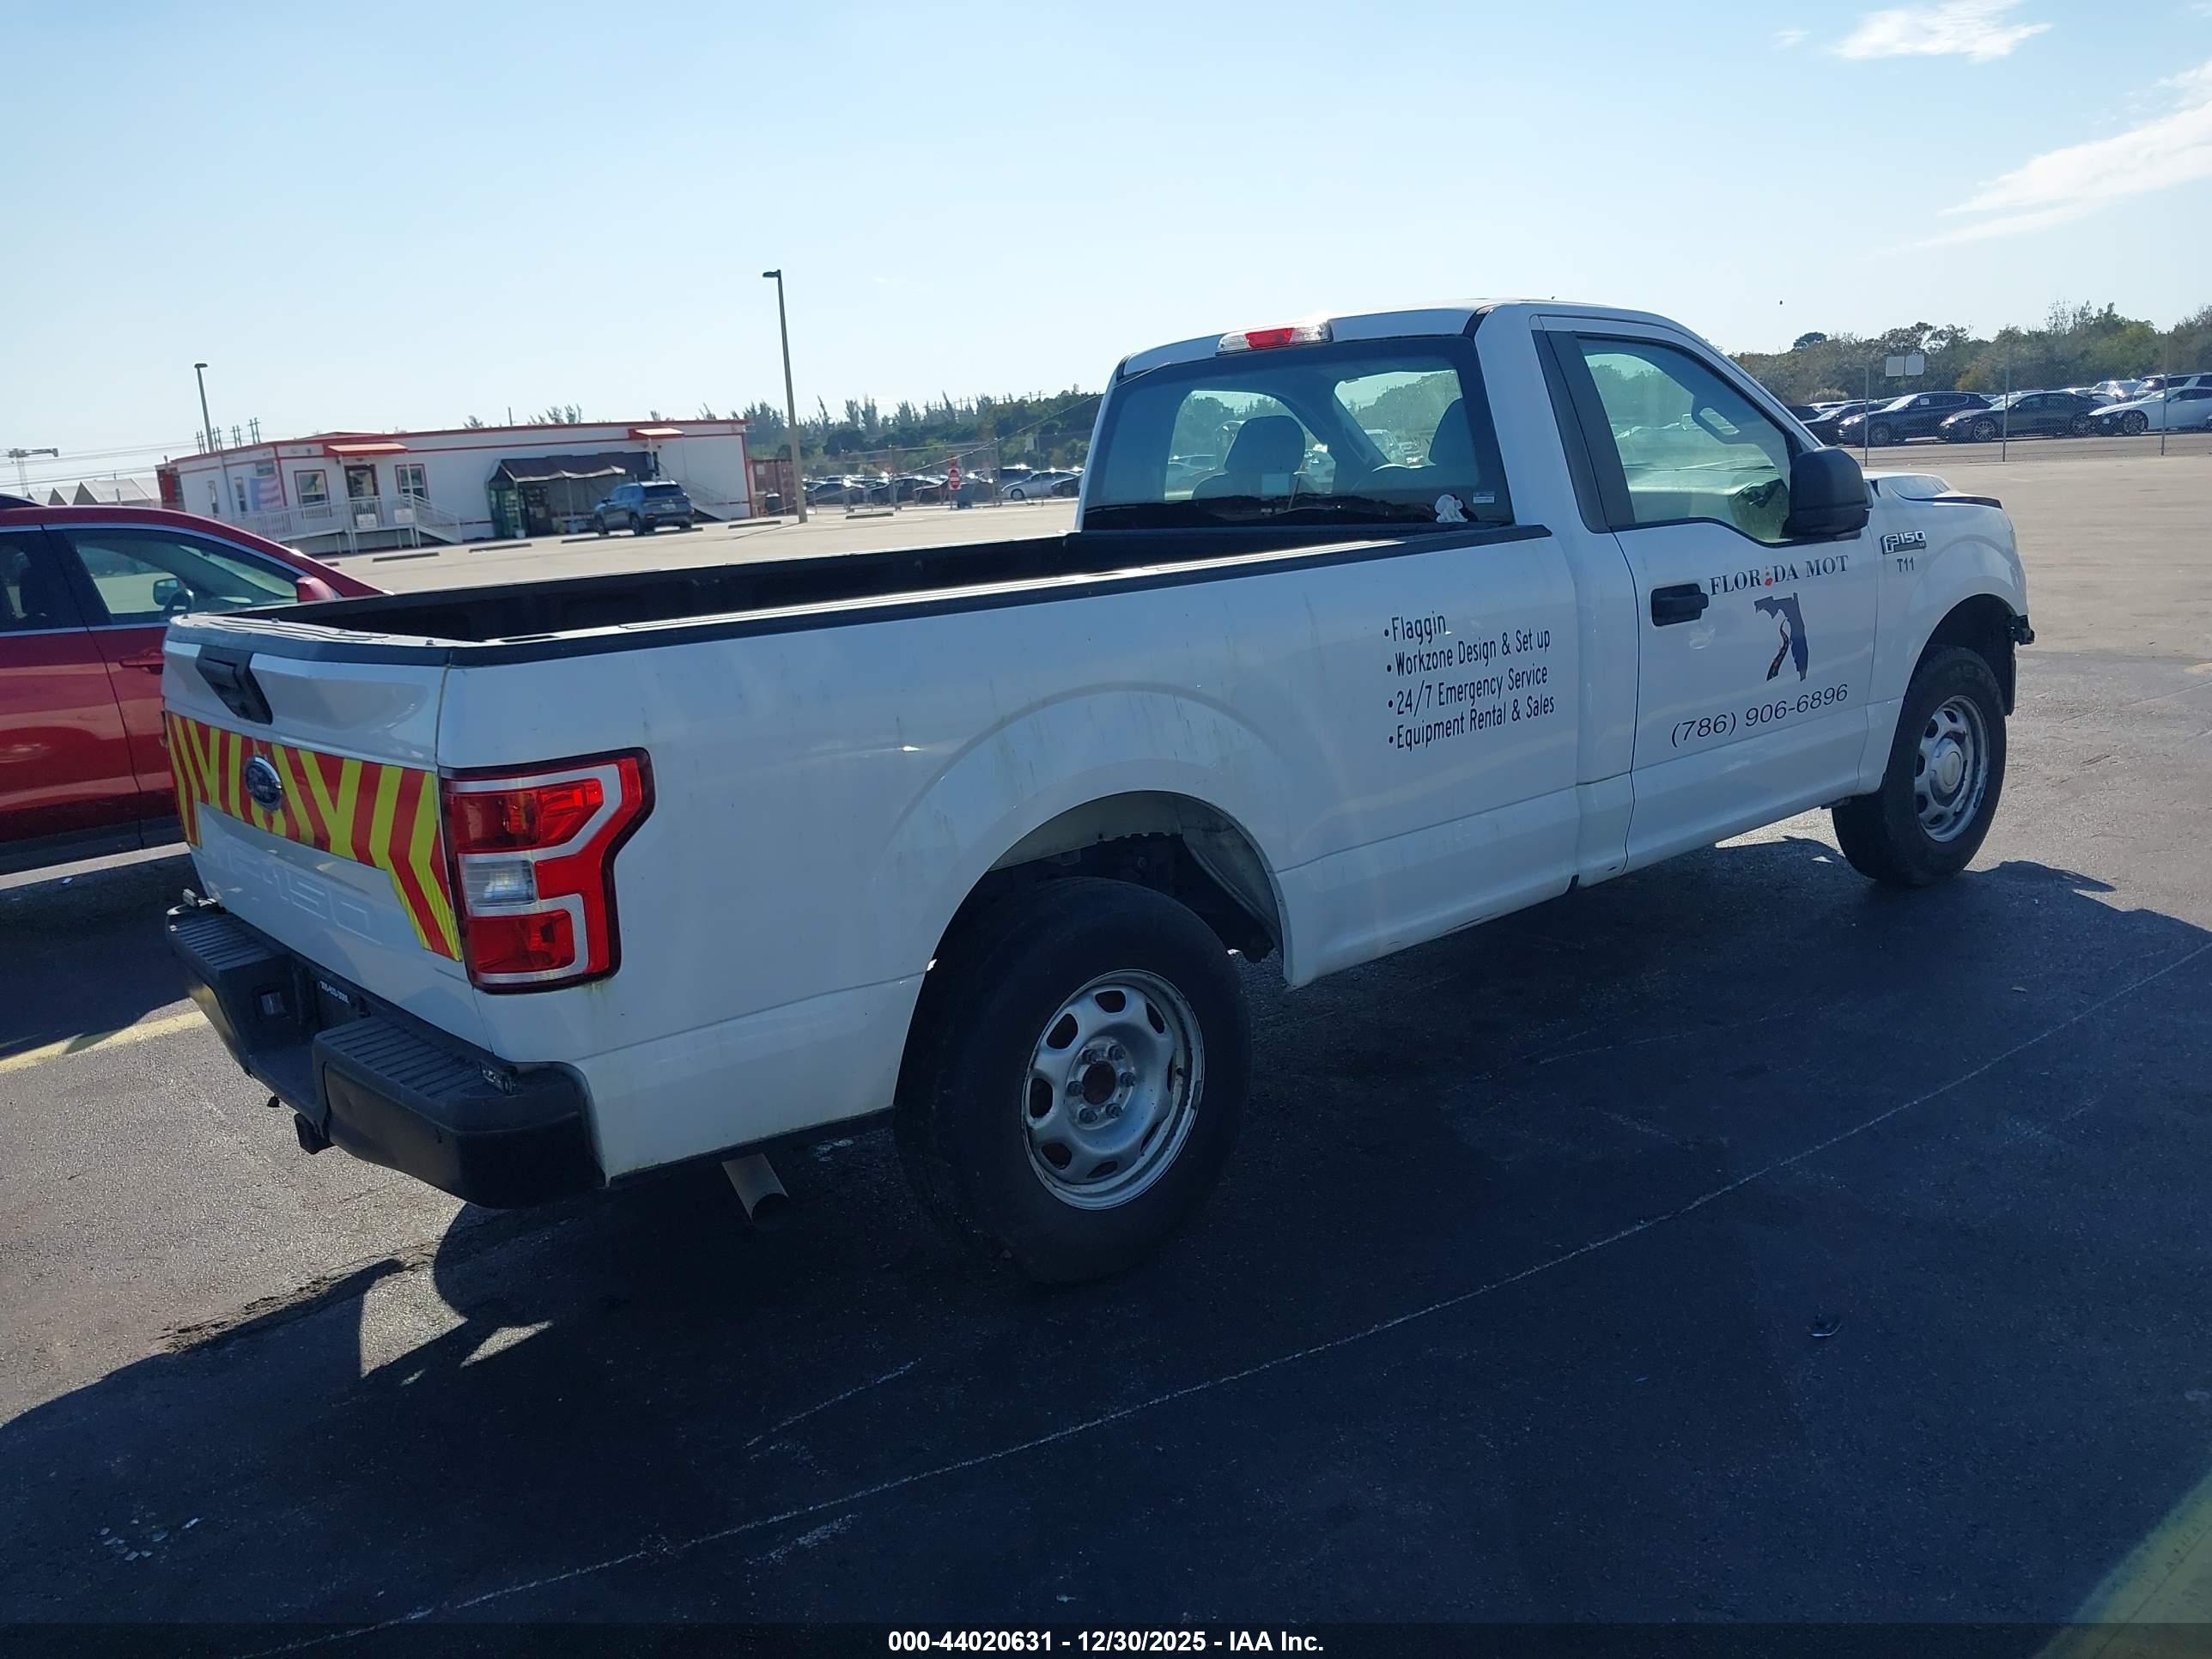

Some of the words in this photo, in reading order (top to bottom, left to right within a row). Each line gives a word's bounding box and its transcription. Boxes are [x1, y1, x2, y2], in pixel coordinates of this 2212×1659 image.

[1804, 555, 1849, 578] MOT
[1391, 611, 1446, 646] Flaggin
[1395, 648, 1454, 677] Workzone
[1457, 636, 1497, 666] Design
[1501, 631, 1511, 656] &
[1516, 628, 1533, 653] Set
[1536, 629, 1551, 653] up
[1396, 679, 1433, 718] 24/7
[1437, 675, 1504, 707] Emergency
[1508, 663, 1548, 690] Service
[1671, 712, 1737, 749] (786)
[1745, 684, 1849, 727] 906-6896
[1396, 711, 1465, 752] Equipment
[1468, 702, 1507, 732] Rental
[1511, 697, 1522, 722] &
[1526, 693, 1555, 720] Sales
